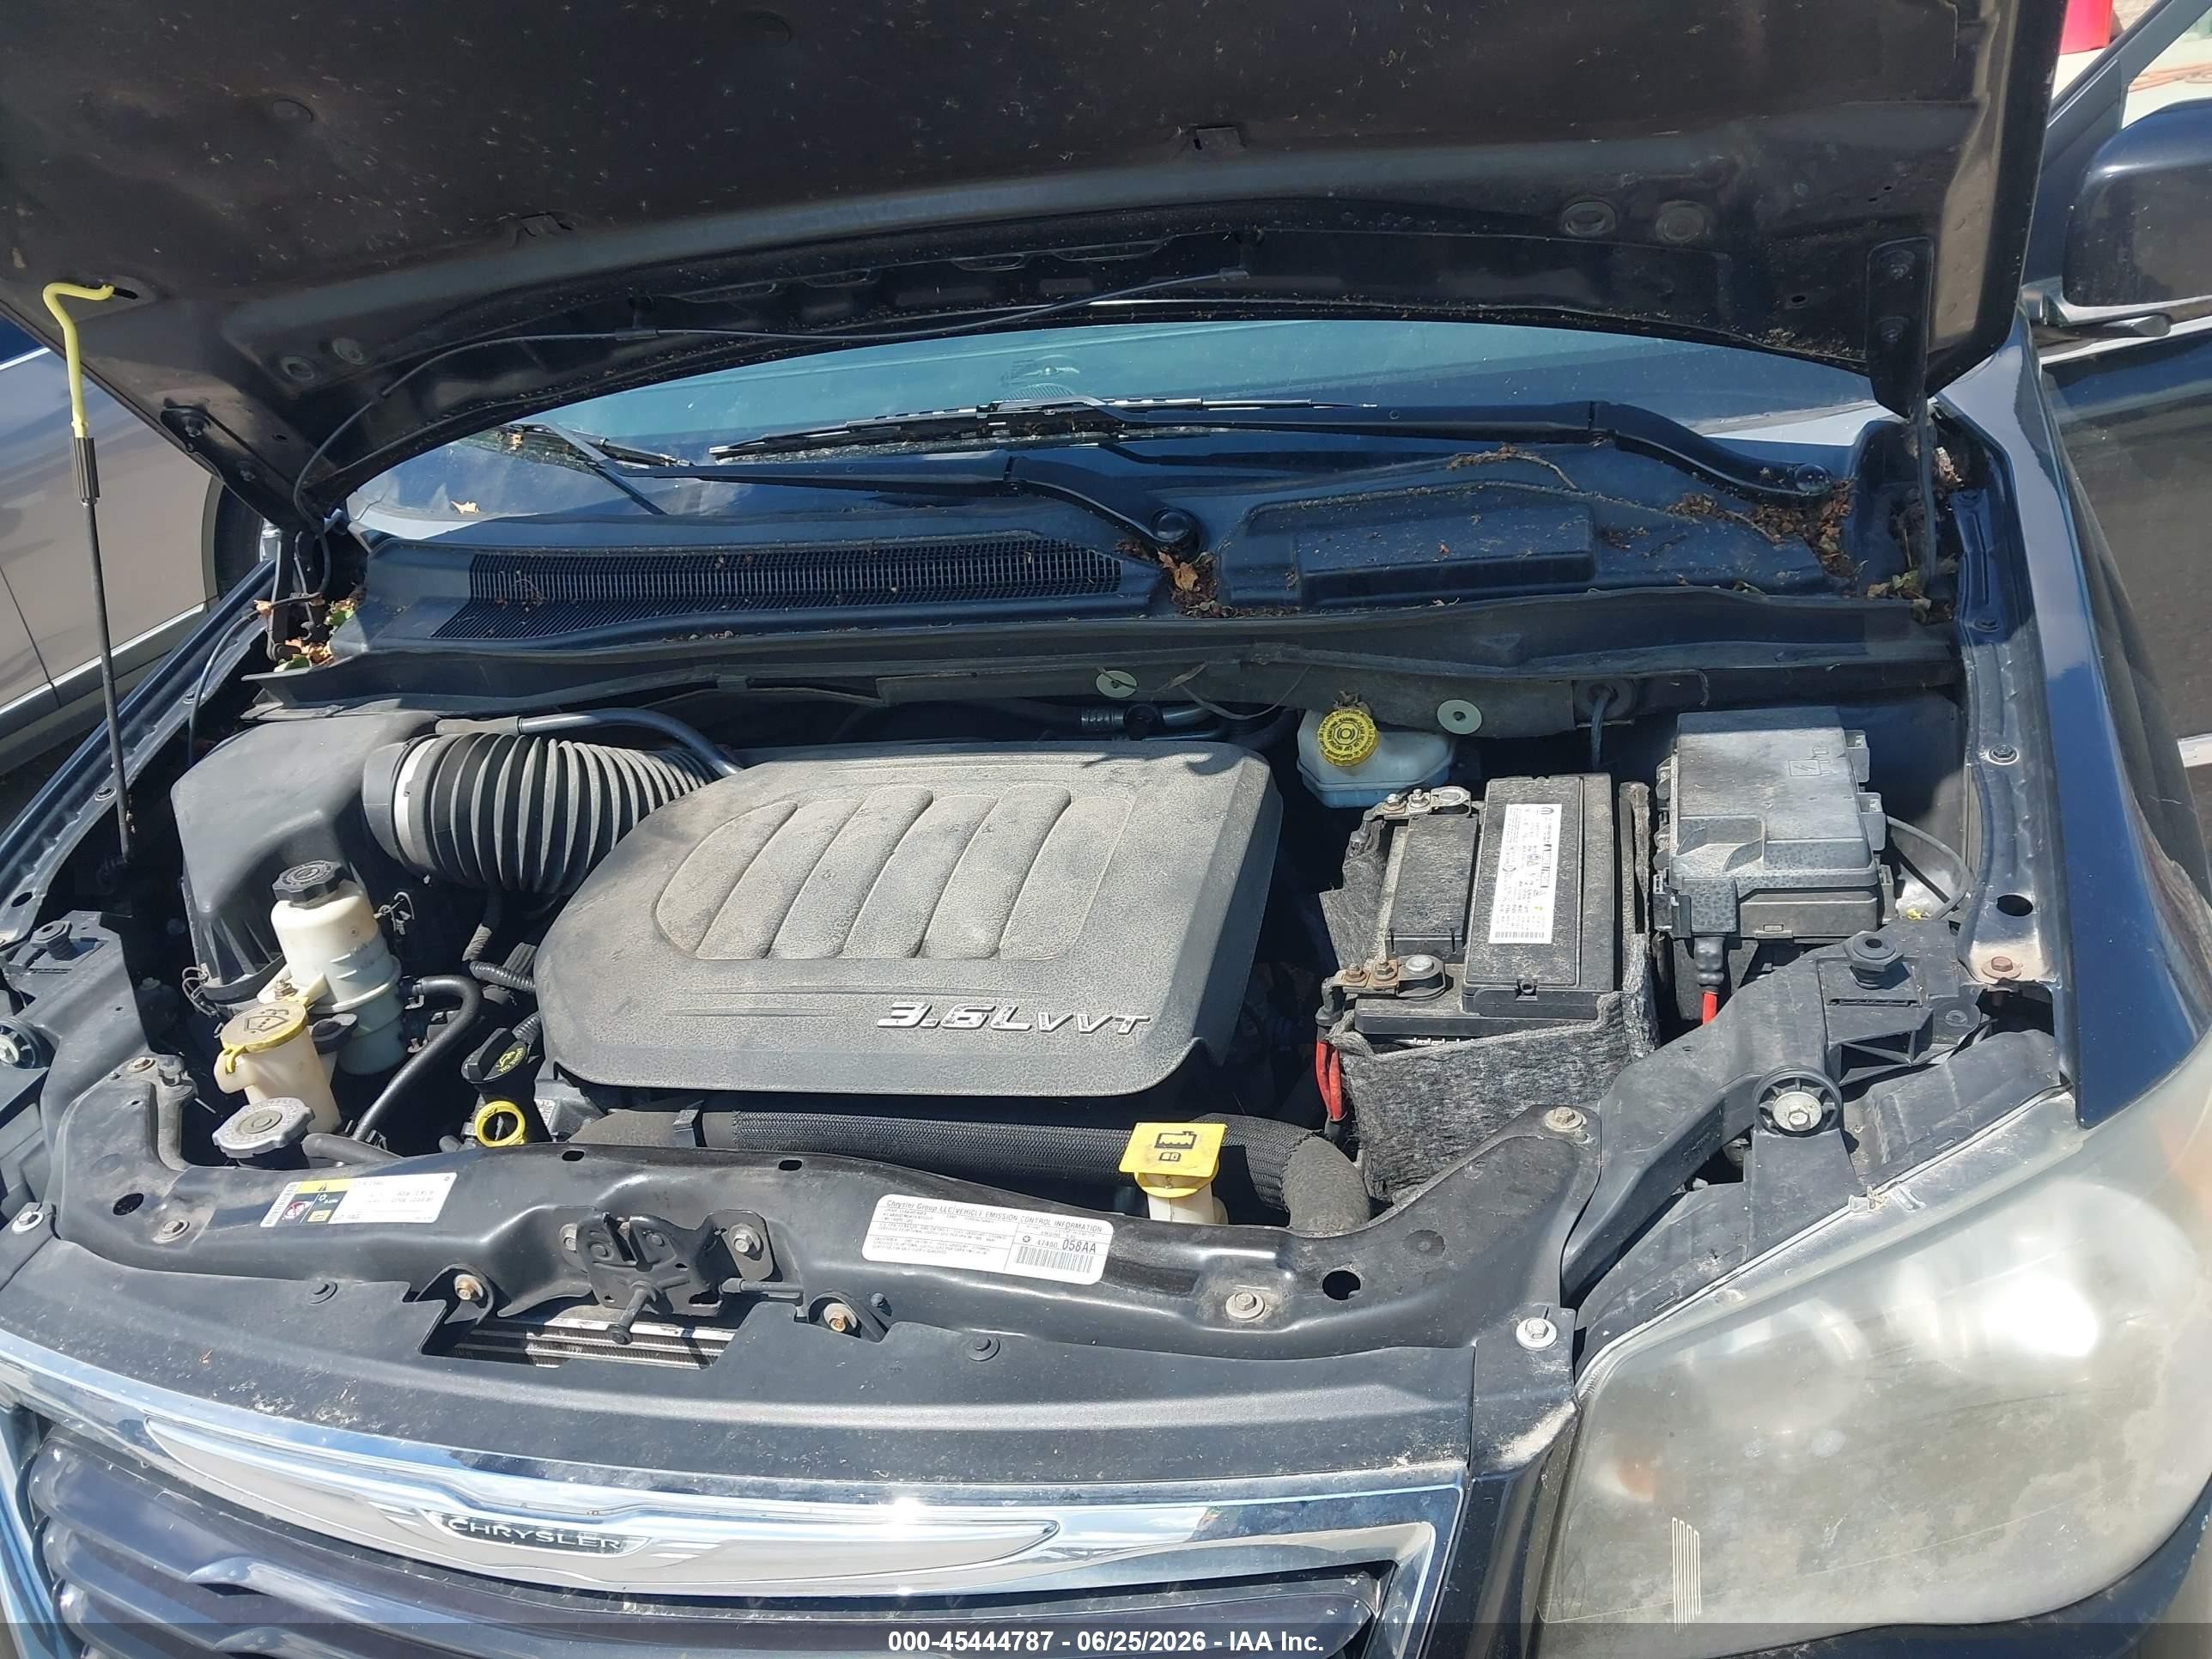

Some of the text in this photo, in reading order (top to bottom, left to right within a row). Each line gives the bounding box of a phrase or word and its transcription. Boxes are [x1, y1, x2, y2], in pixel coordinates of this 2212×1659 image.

[886, 1200, 915, 1209] Chrysler
[916, 1202, 938, 1212] Group
[955, 1207, 983, 1218] VEHICLE
[985, 1210, 1018, 1221] EMISSION
[1021, 1215, 1051, 1226] CONTROL
[1054, 1219, 1103, 1233] INFORMATION
[1061, 1238, 1097, 1254] 058AA
[447, 1517, 622, 1550] CHRYSLER
